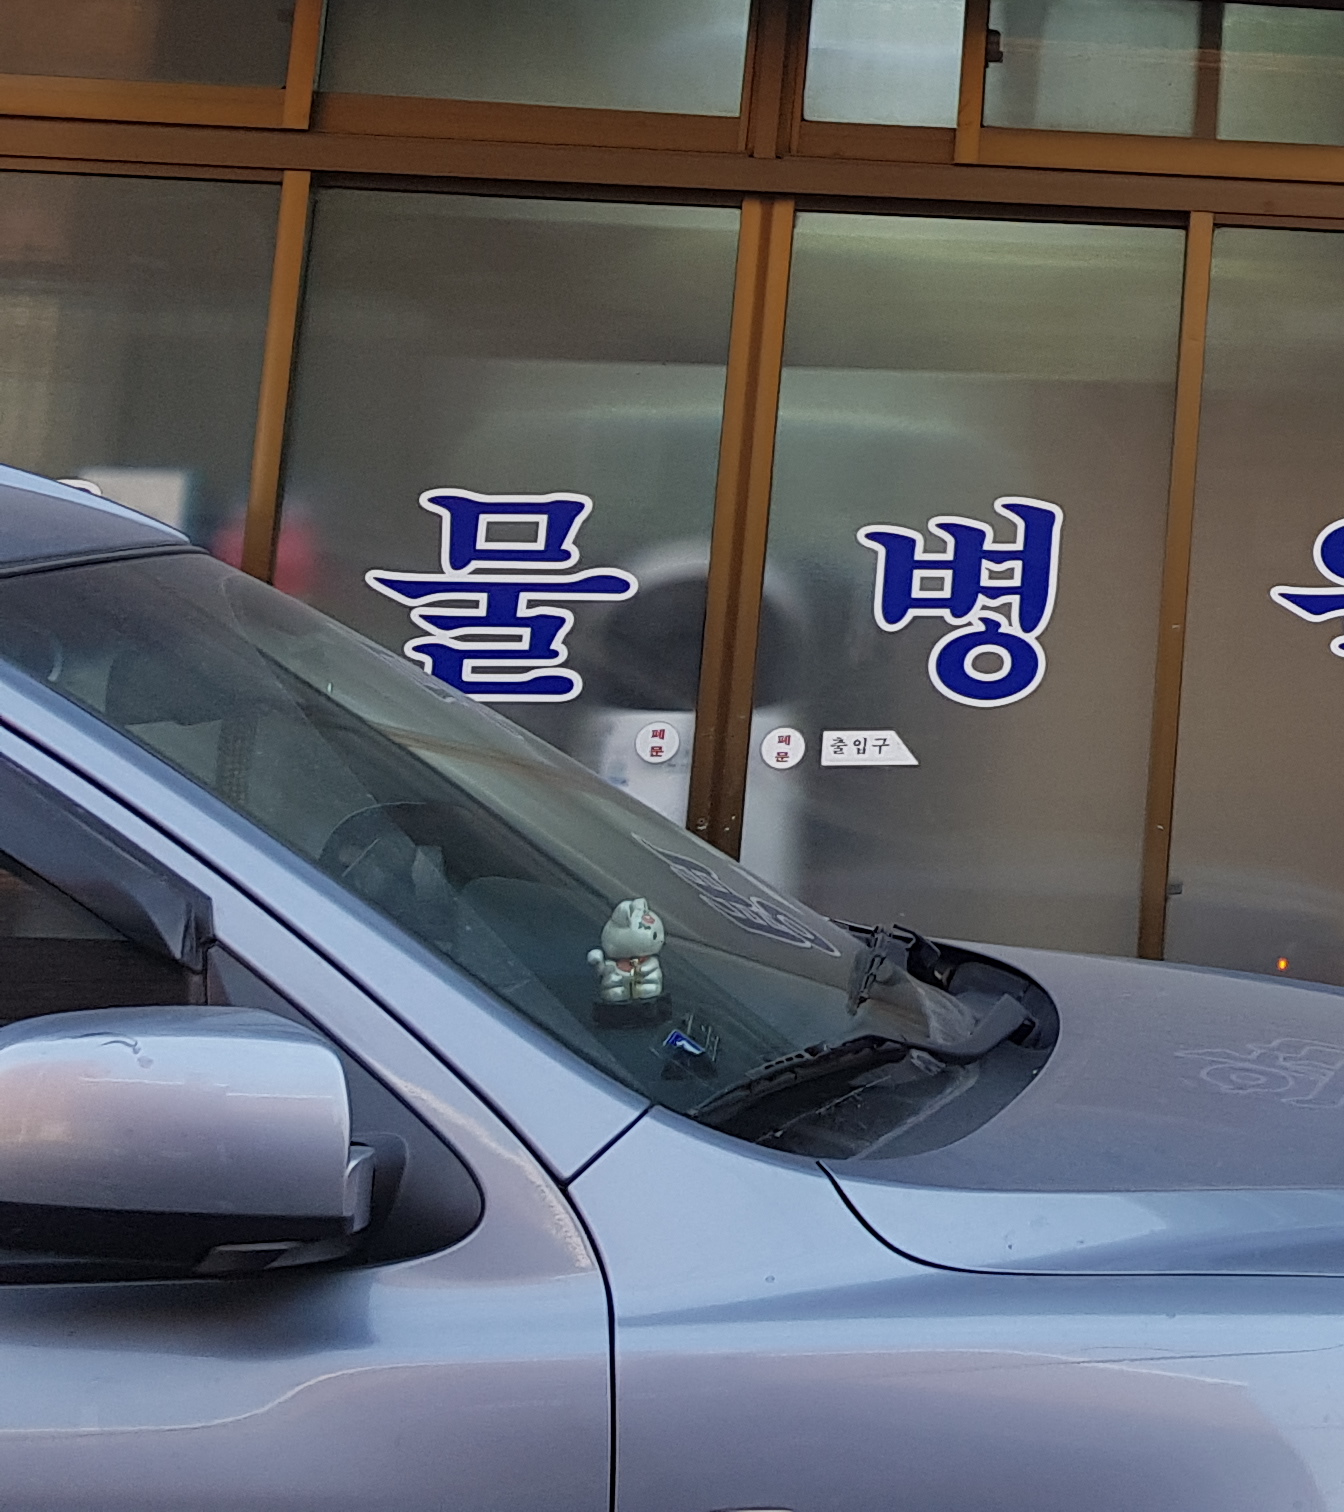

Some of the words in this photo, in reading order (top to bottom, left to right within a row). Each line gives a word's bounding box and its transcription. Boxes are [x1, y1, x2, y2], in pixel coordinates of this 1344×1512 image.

[365, 487, 639, 702] 물
[856, 496, 1063, 708] 병
[829, 736, 891, 756] 출입구
